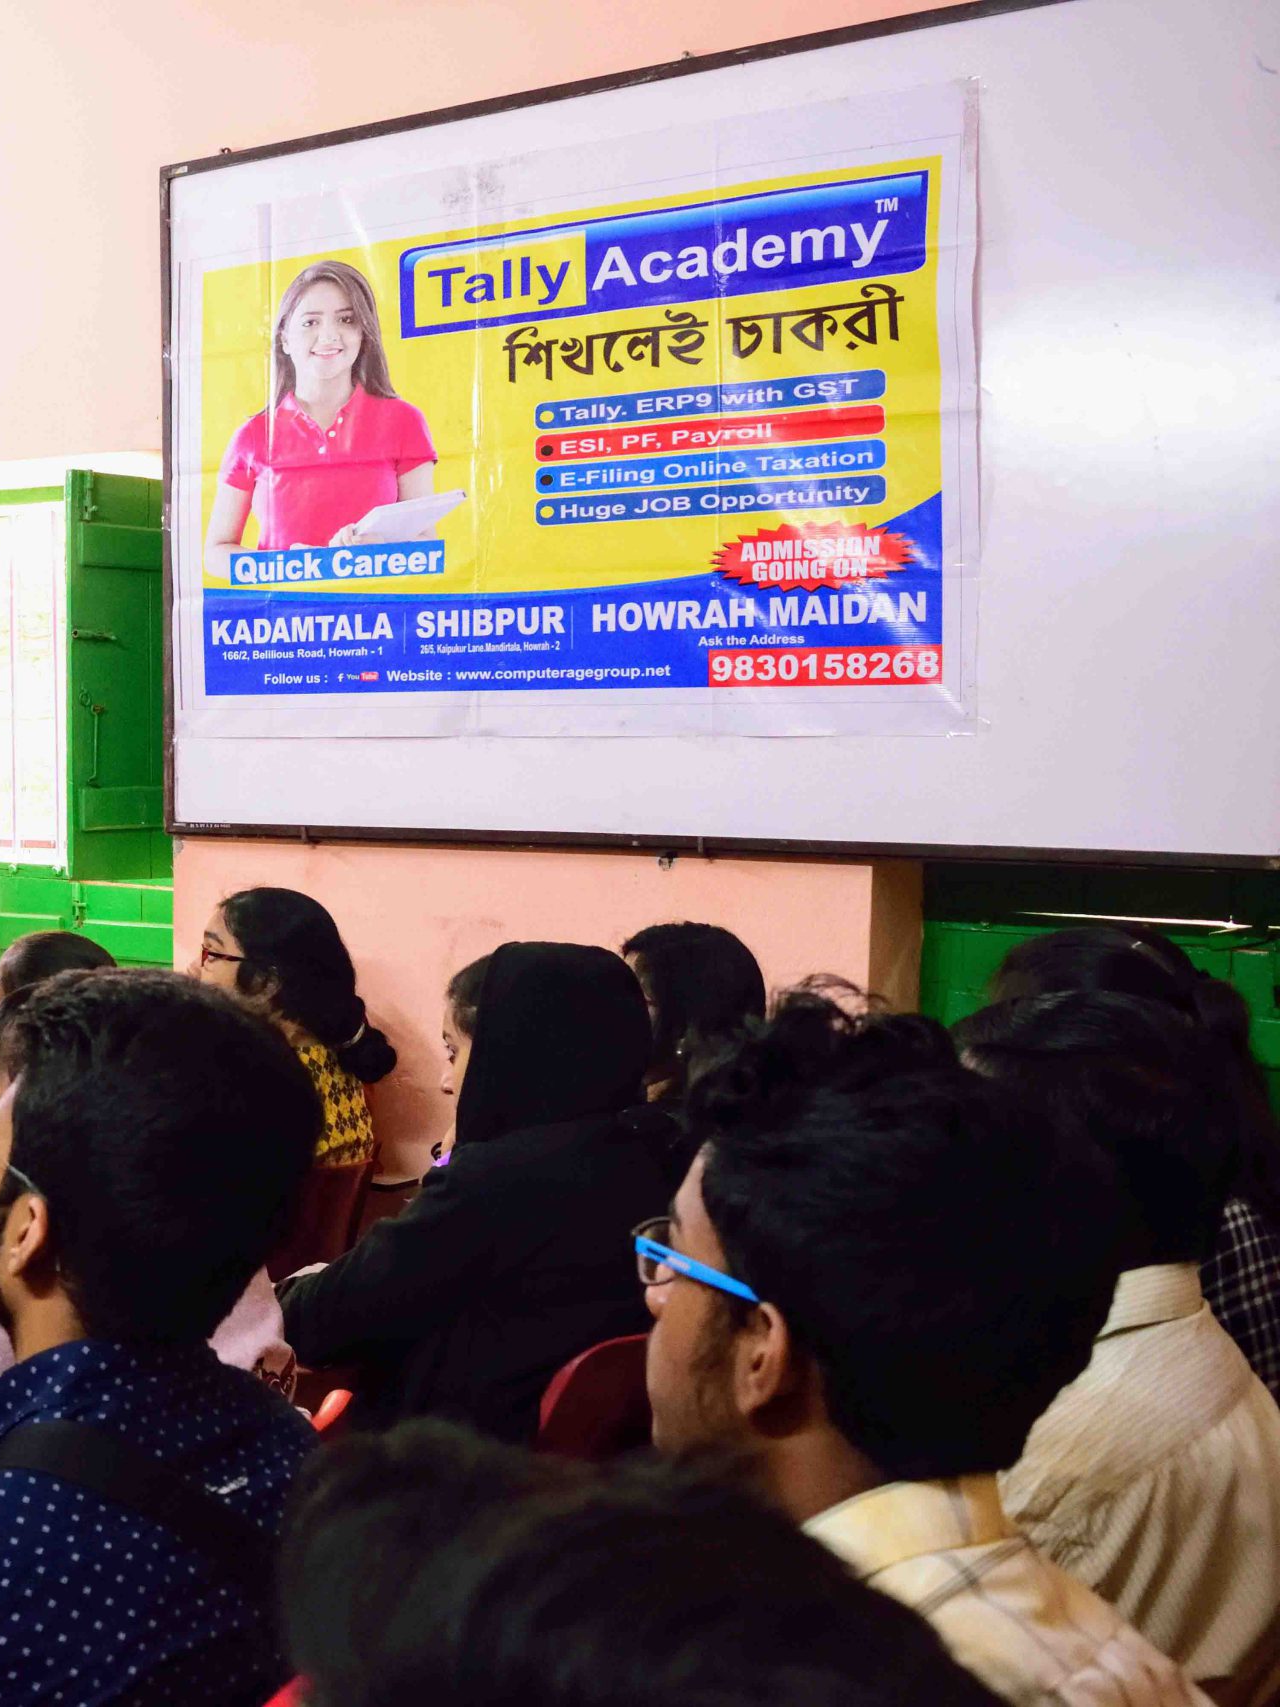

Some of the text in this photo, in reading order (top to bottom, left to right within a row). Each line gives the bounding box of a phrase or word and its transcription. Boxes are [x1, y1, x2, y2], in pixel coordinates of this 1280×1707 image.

[428, 255, 571, 307] Tally
[592, 219, 889, 290] Academy
[503, 284, 904, 383] শিখলেই চাকরী
[560, 379, 859, 422] Tally. ERP9 with GST
[560, 423, 772, 456] ESI, PF, Payroll
[560, 449, 874, 487] E-Filing Online Taxation
[560, 483, 870, 523] Huge JOB Opportunity
[741, 535, 880, 562] ADMISSION
[234, 550, 442, 584] Quick Career
[751, 558, 868, 582] GOING ON
[211, 612, 393, 645] KADAMTALA
[415, 605, 565, 638] SHIBPUR
[592, 592, 927, 632] HOWRAH MAIDAN
[297, 648, 326, 659] Road,
[328, 647, 368, 657] Howrah
[523, 641, 550, 651] Howrah
[555, 640, 561, 650] 2
[698, 634, 805, 647] Ask the Address
[264, 673, 305, 685] Follow
[306, 674, 321, 684] us
[386, 670, 442, 683] Website
[455, 664, 671, 682] www.computeragegroup.net
[712, 652, 939, 682] 9830158268
